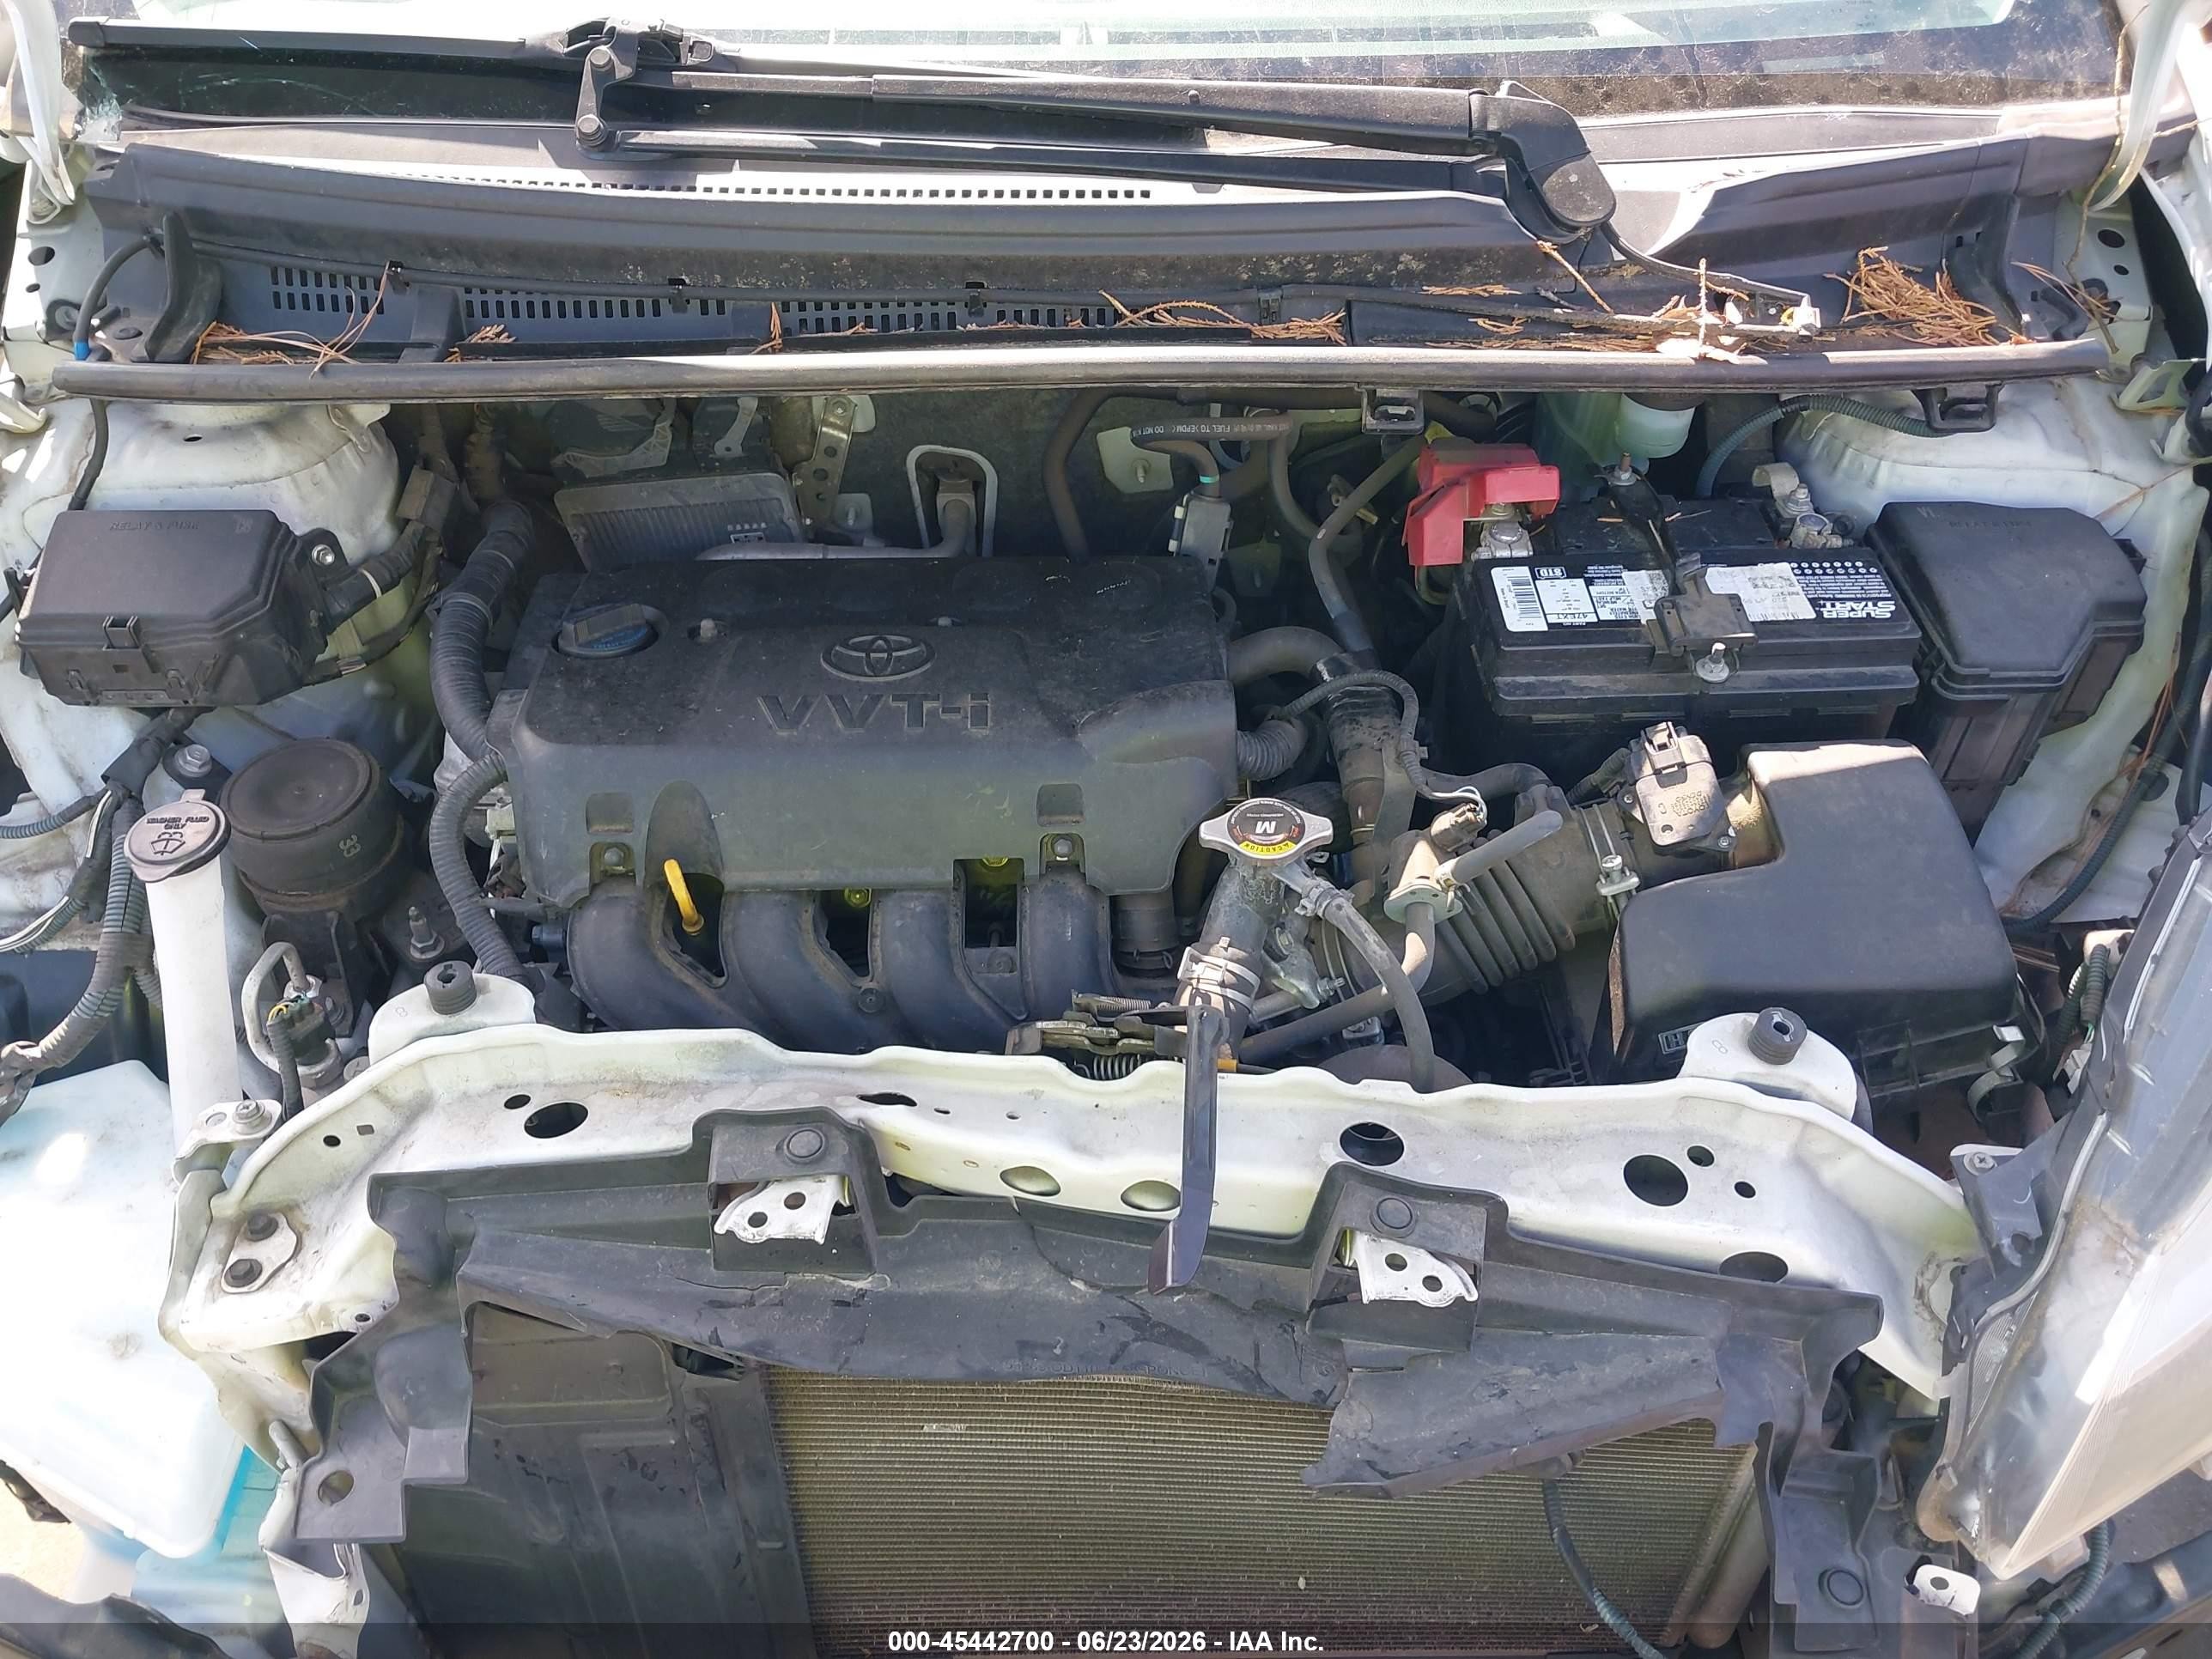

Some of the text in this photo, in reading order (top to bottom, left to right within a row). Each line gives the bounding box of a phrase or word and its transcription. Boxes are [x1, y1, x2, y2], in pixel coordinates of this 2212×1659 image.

[1820, 601, 1896, 611] START
[1822, 610, 1891, 618] SUPER
[757, 693, 990, 732] VVT-i
[1255, 821, 1276, 834] M
[1243, 842, 1283, 853] CAUTION
